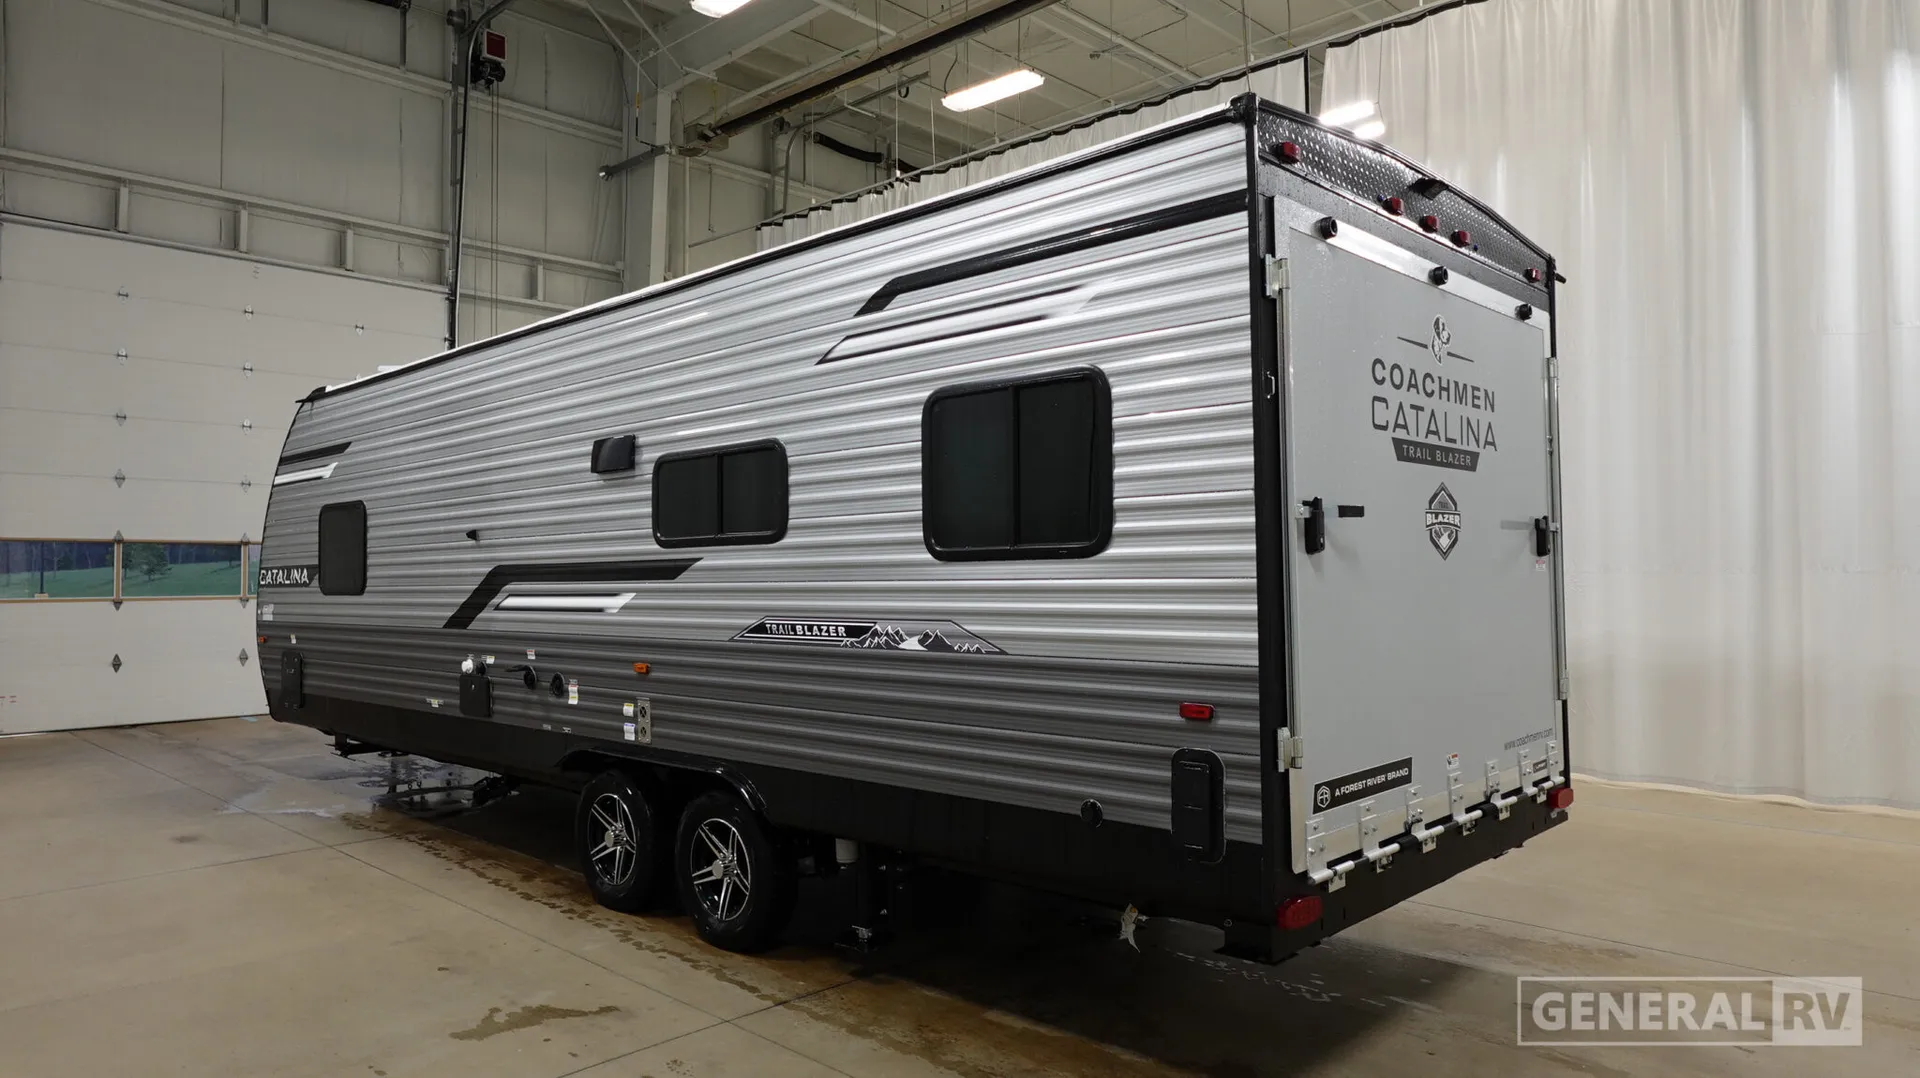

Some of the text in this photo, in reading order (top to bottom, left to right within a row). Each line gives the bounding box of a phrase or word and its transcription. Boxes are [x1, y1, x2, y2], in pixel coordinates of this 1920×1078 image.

[1371, 357, 1496, 413] COACHMEN
[1371, 395, 1498, 452] CATALINA
[1402, 444, 1472, 467] TRAIL BLAZER
[1426, 513, 1461, 526] BLAZER
[259, 567, 310, 585] CATALINA
[765, 623, 847, 637] TRAIL BLAZER
[1334, 788, 1341, 797] A
[1340, 780, 1367, 796] FOREST
[1387, 767, 1409, 781] BRAND
